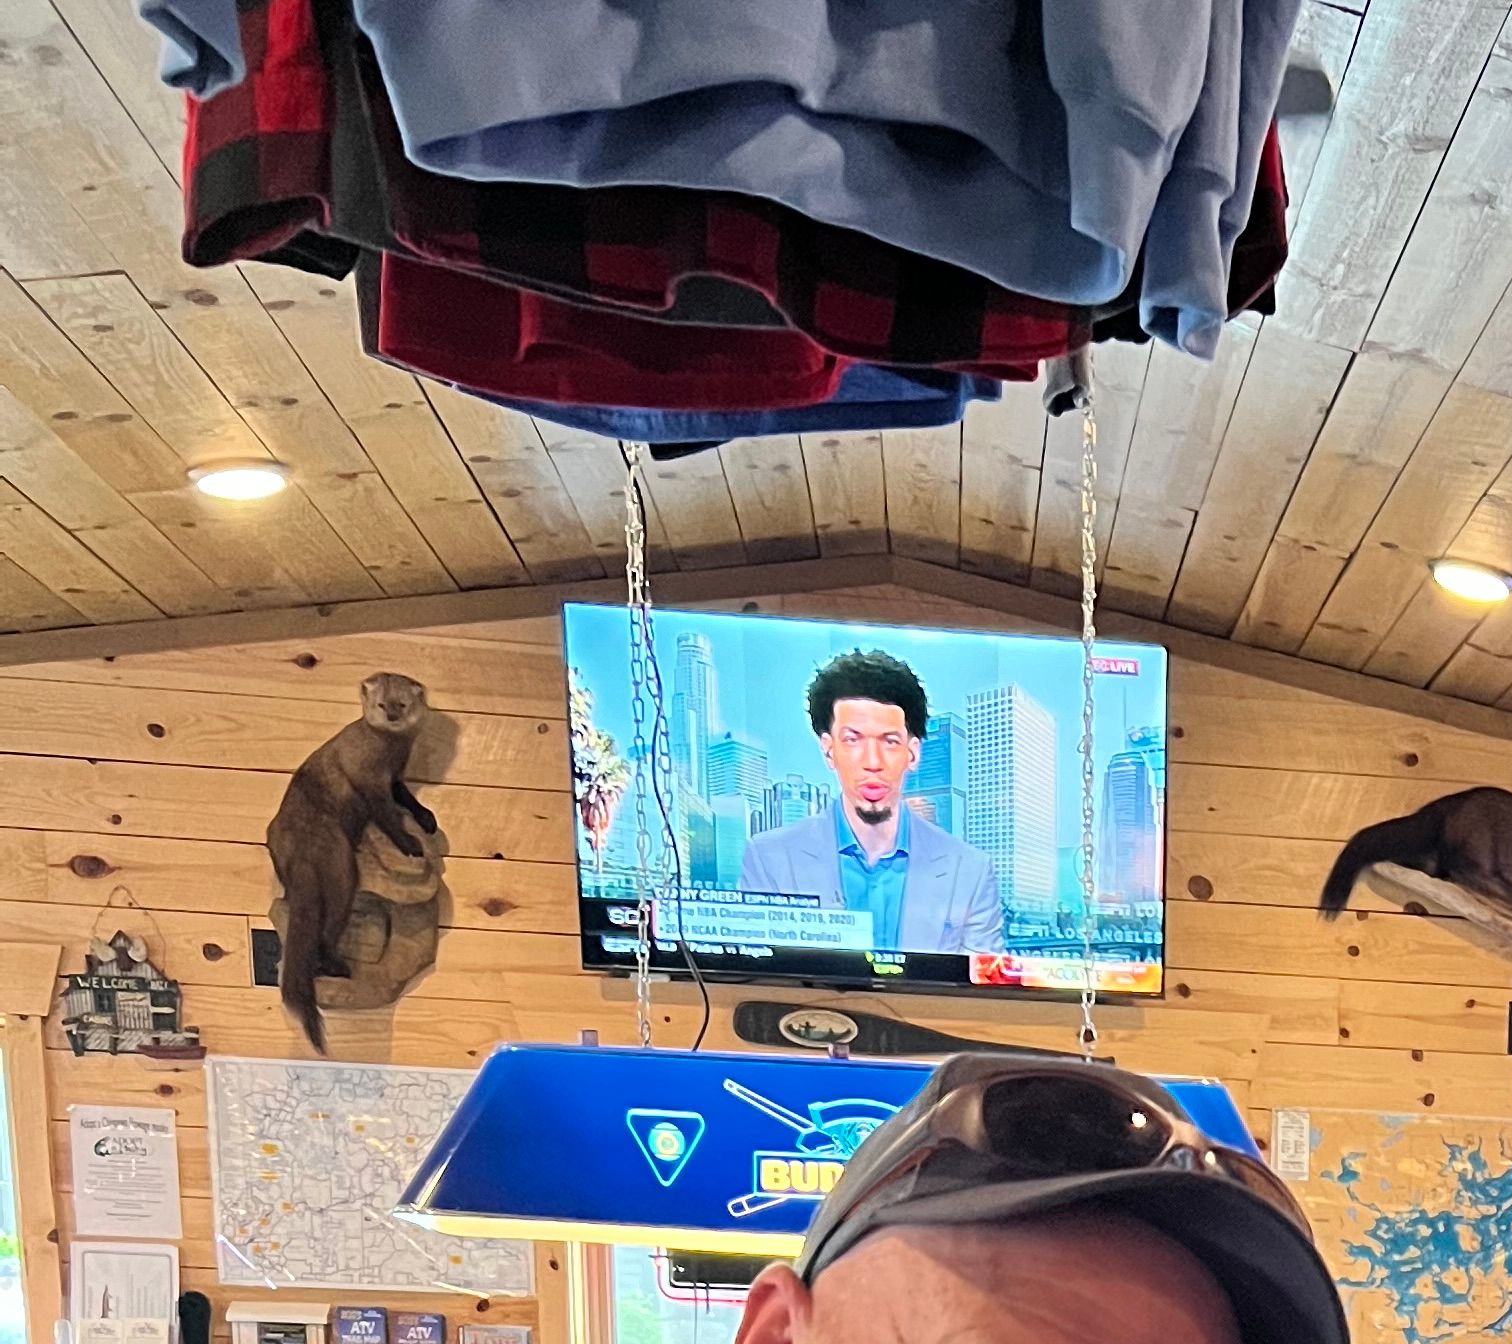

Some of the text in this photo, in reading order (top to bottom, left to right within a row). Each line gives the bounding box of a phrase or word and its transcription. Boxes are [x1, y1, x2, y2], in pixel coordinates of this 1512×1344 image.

[699, 890, 743, 903] GREEN
[1090, 929, 1164, 944] ANGELES
[76, 976, 139, 990] WELCOME
[350, 1320, 375, 1334] ATV
[407, 1326, 432, 1340] ATV
